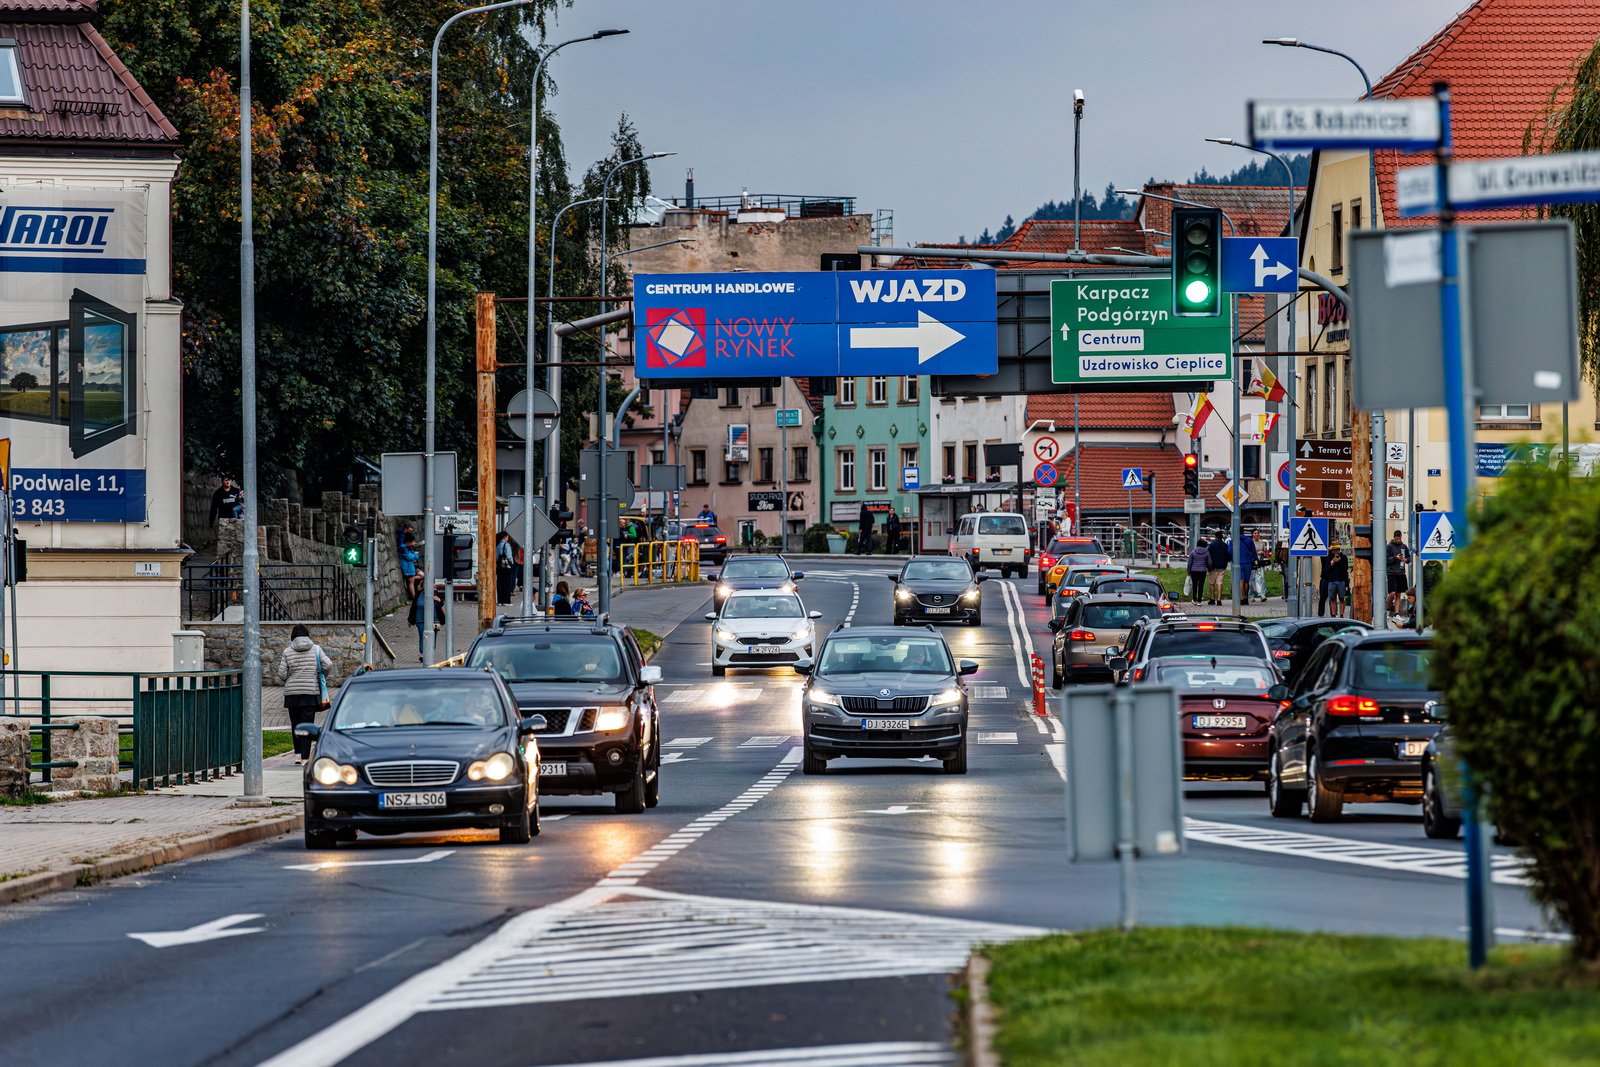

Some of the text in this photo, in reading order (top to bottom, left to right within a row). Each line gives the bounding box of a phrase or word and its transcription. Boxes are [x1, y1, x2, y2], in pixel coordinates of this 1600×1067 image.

[645, 282, 796, 295] CENTRUM HANDLOWE
[849, 278, 968, 304] WJAZD
[1077, 285, 1150, 304] Karpacz
[1077, 306, 1168, 326] Podgórzyn
[715, 317, 796, 338] NOWY
[1082, 333, 1141, 345] Centrum
[715, 338, 796, 358] RYNEK
[1082, 357, 1223, 373] Uzdrowisko Cieplice
[1317, 446, 1341, 456] Termy
[1321, 466, 1343, 475] Stare
[12, 473, 126, 496] Podwale 11,
[31, 498, 66, 517] 843
[144, 563, 152, 571] 11
[867, 720, 908, 729] DJ 3326E
[1199, 717, 1244, 726] DJ 9295A
[1408, 743, 1422, 754] DJ
[386, 794, 411, 806] NSZ
